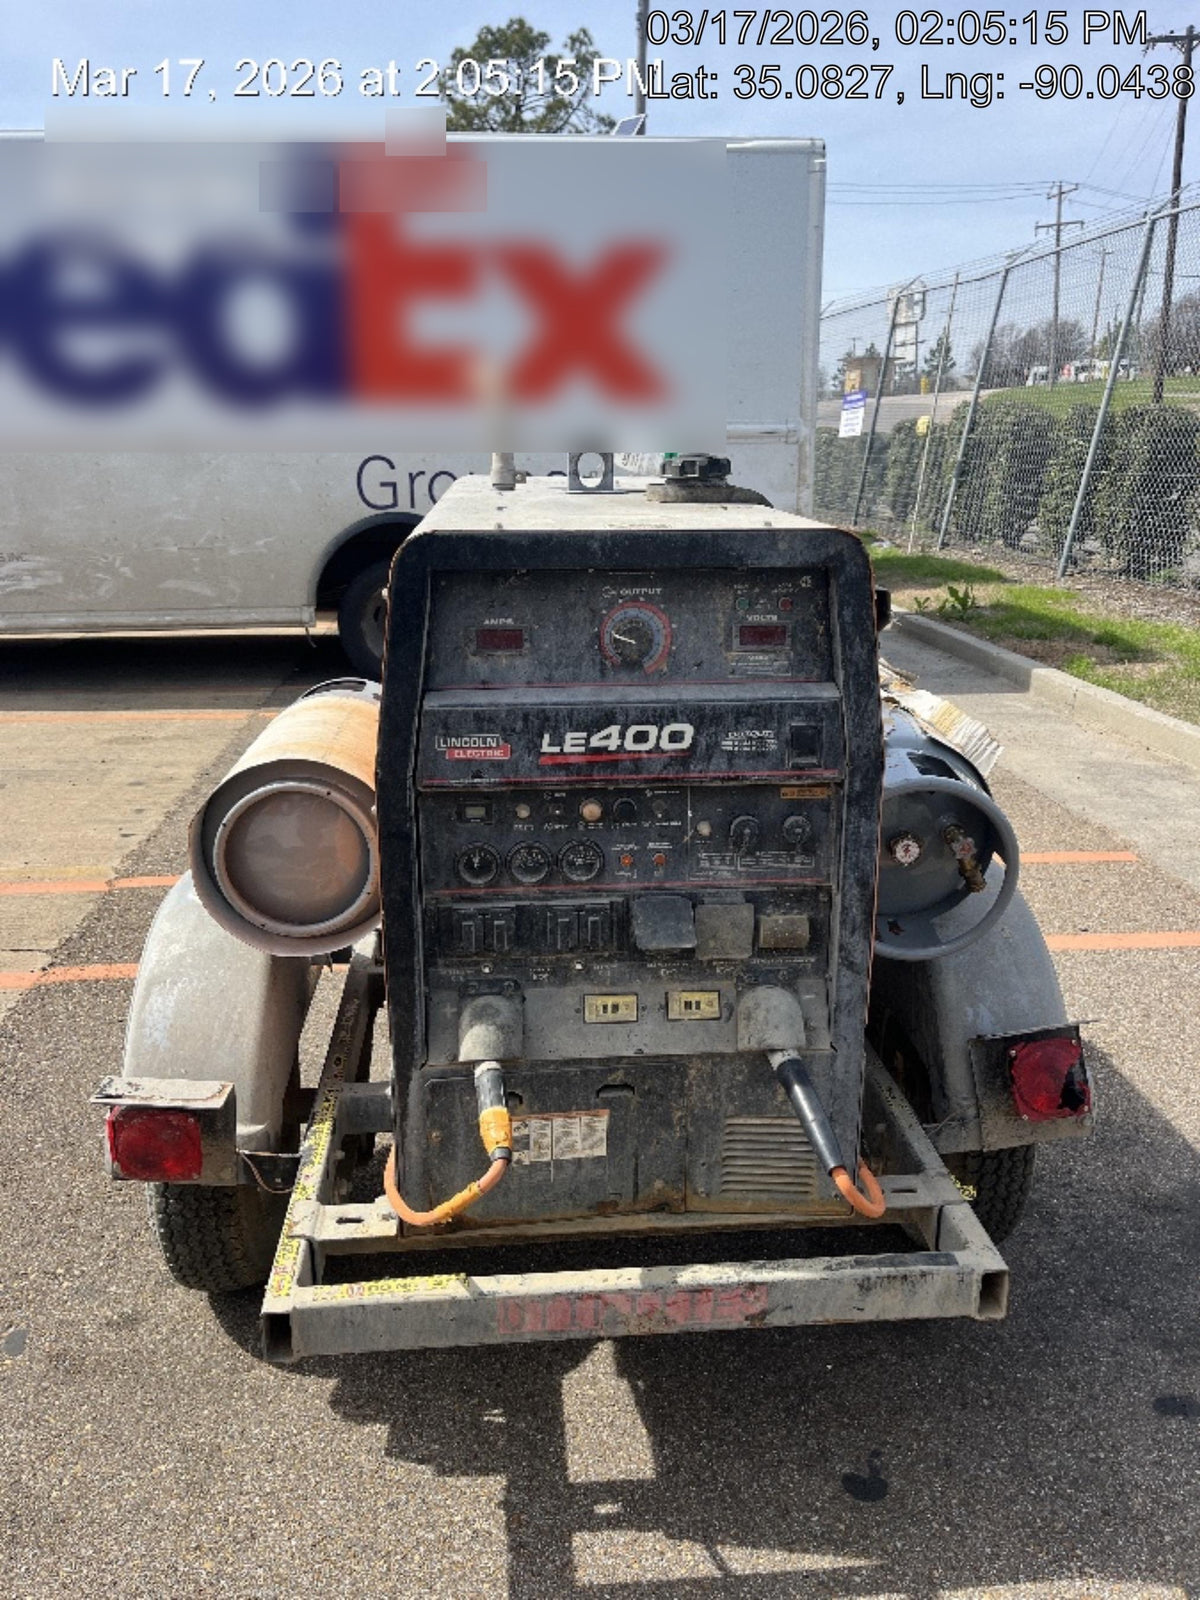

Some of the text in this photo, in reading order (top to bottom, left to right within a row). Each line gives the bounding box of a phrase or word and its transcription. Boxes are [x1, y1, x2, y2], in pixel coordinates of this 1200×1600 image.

[619, 587, 662, 595] OUTPUT
[439, 736, 498, 748] LINCOLN
[540, 723, 695, 754] LE400
[453, 748, 505, 758] ELECTRIC
